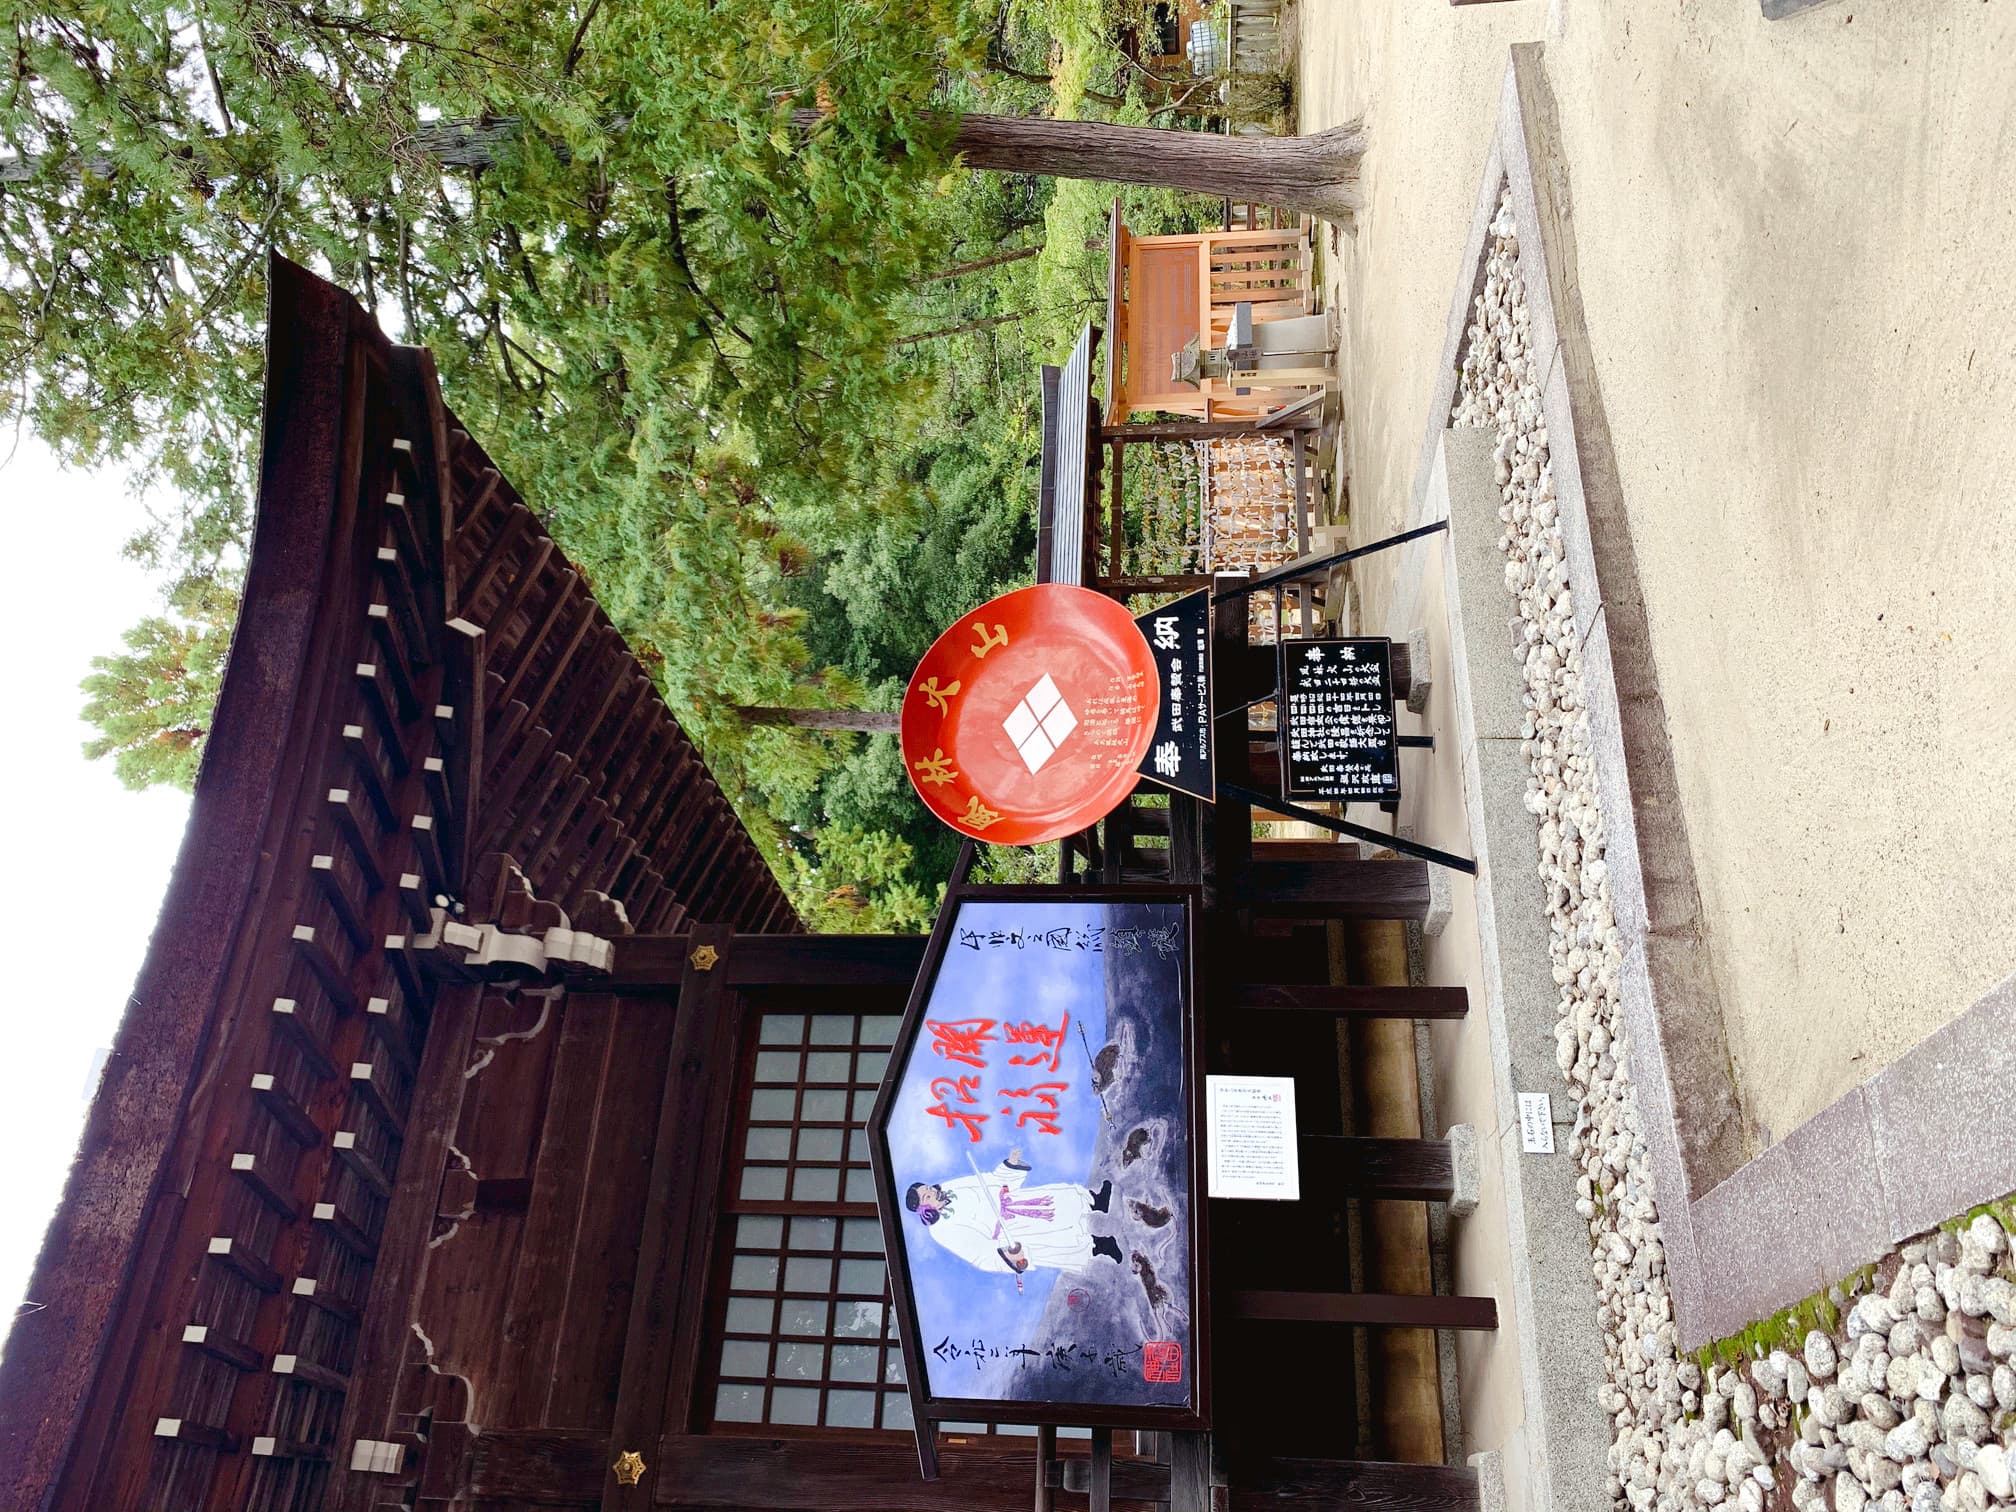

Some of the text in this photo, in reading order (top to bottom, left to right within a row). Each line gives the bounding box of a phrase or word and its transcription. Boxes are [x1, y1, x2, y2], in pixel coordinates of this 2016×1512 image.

[1304, 646, 1356, 662] 奉納
[1153, 616, 1182, 778] 奉 納
[1170, 657, 1183, 732] 武田奉賛会
[924, 1010, 1069, 1072] 開運
[924, 1075, 1069, 1143] 招福
[933, 1336, 1142, 1377] 令和二年庚子歳
